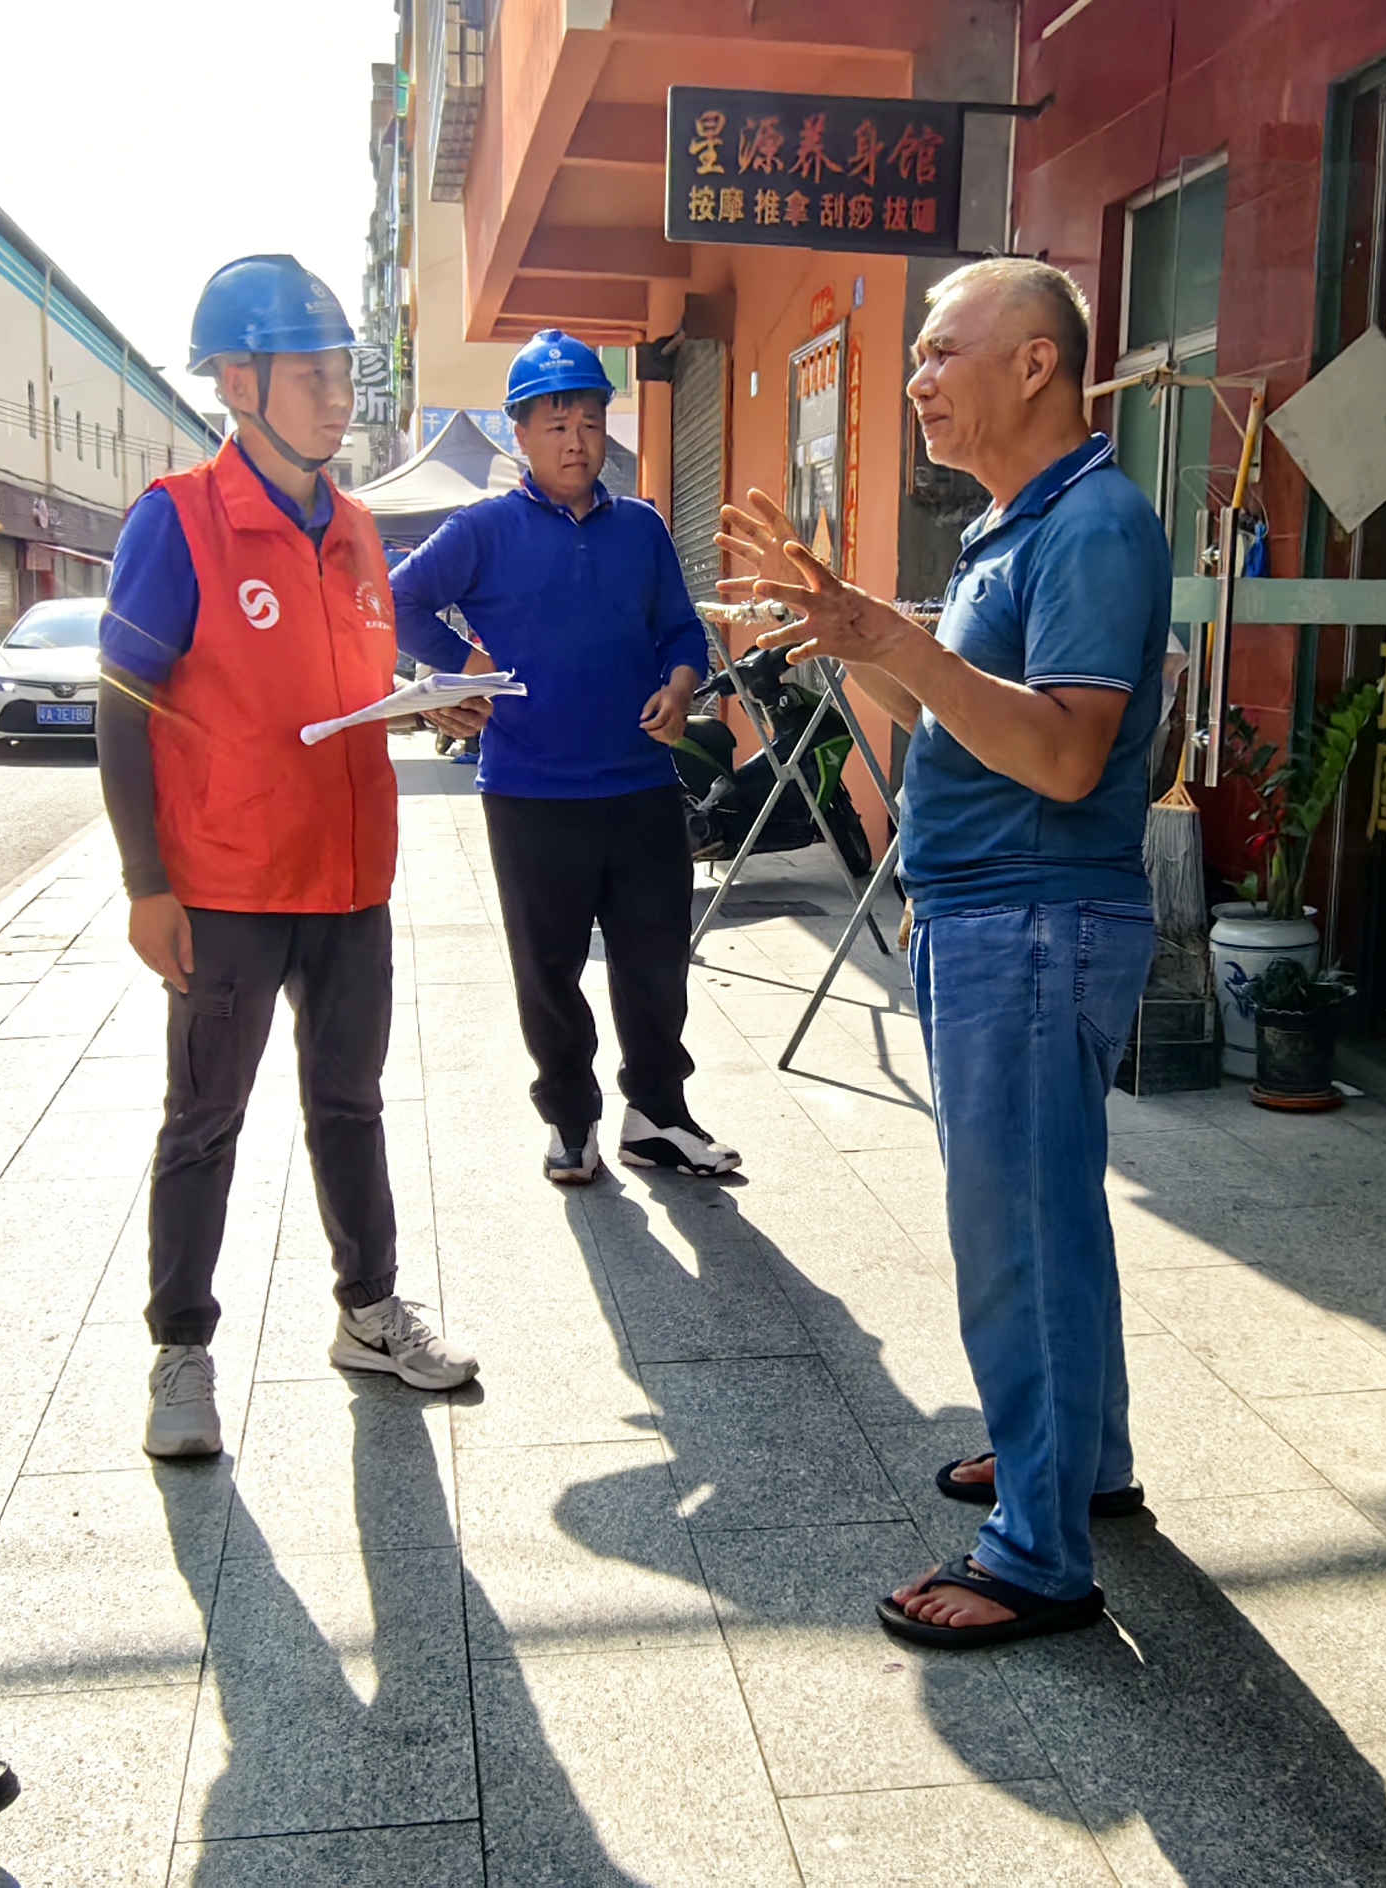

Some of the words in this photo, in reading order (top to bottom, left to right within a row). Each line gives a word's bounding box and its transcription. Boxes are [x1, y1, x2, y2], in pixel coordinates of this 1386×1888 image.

[689, 111, 945, 186] 星源养身馆
[688, 185, 744, 224] 按摩
[755, 189, 810, 227] 推拿
[820, 193, 873, 229] 刮痧
